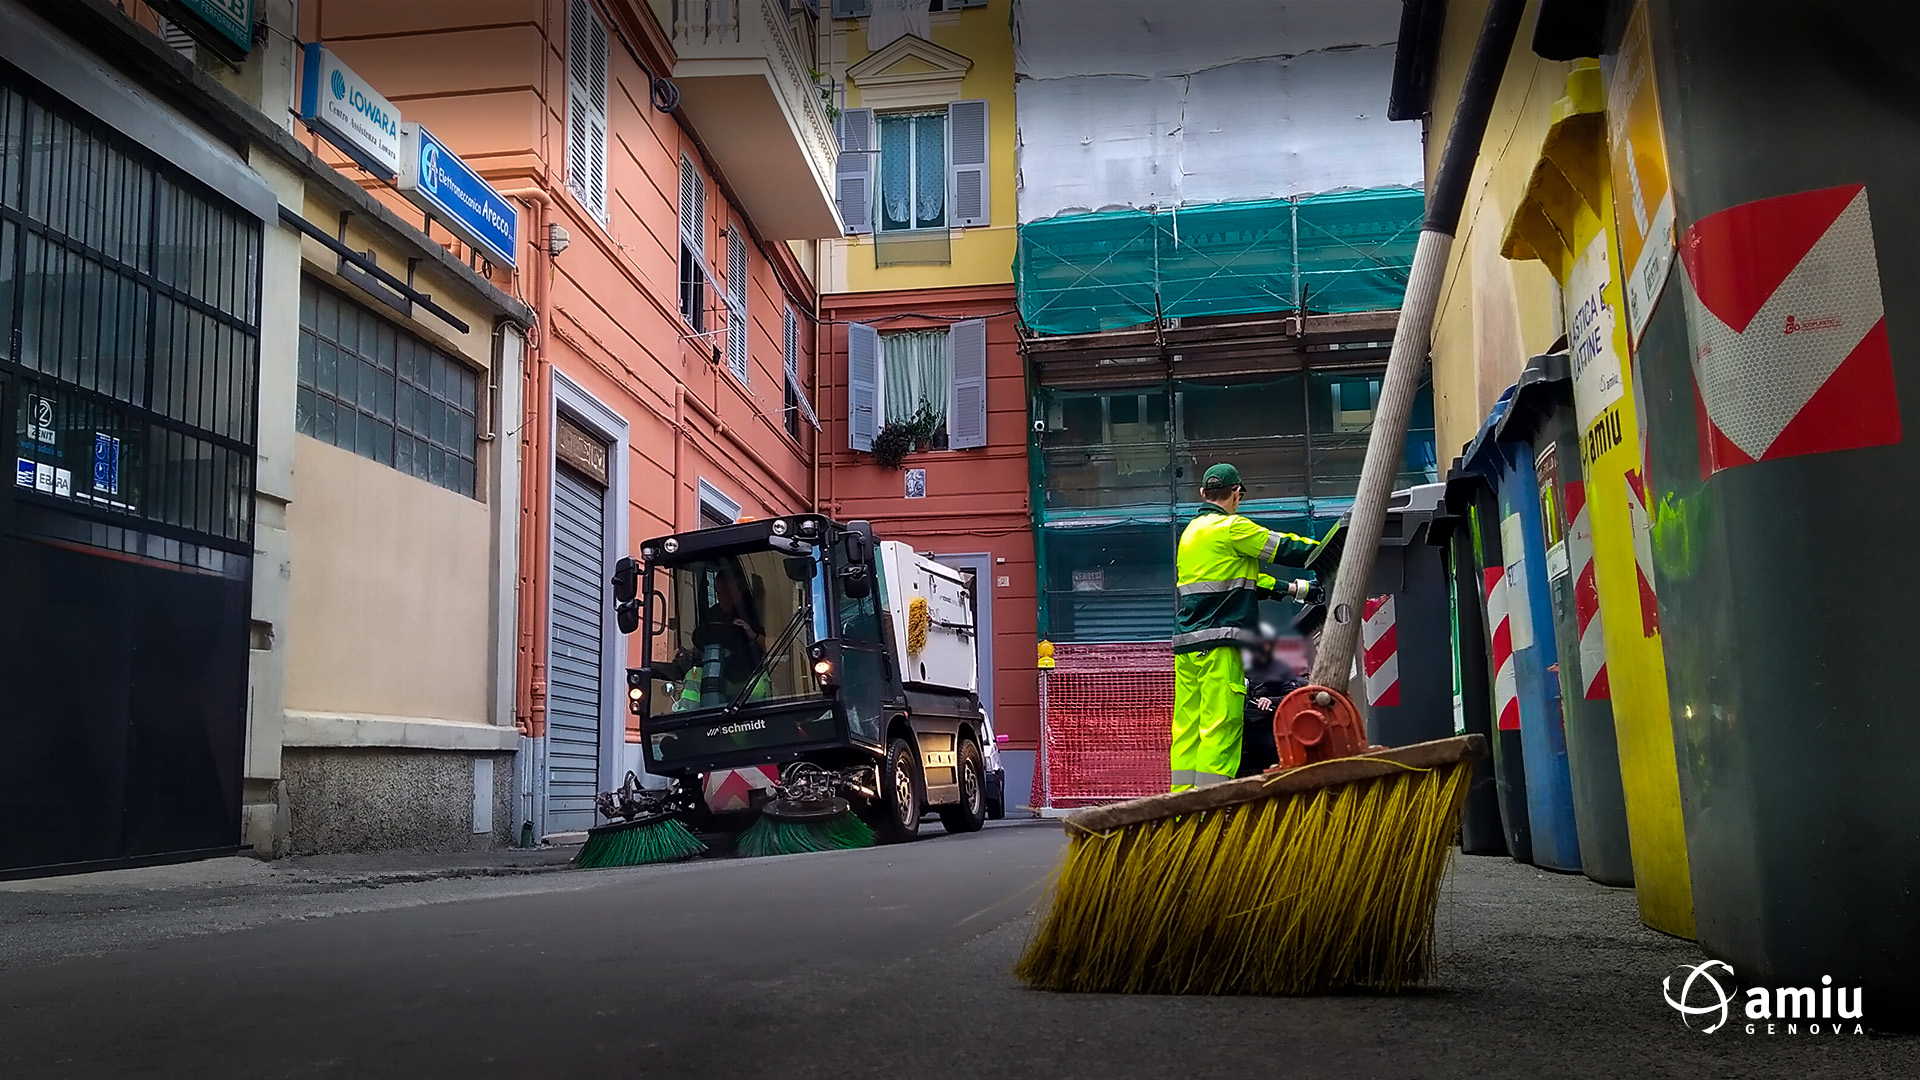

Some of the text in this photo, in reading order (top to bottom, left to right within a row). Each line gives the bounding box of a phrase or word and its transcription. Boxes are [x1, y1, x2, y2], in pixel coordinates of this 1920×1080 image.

[201, 2, 248, 44] PERFORMANCE
[328, 101, 396, 160] Centro Assistenza Lowara
[349, 86, 397, 140] LOWARA
[438, 167, 482, 215] Elettromeccanica
[482, 200, 509, 237] Arecco
[31, 427, 53, 441] ZNIT
[1587, 406, 1623, 464] amiu
[721, 719, 766, 735] schmidt
